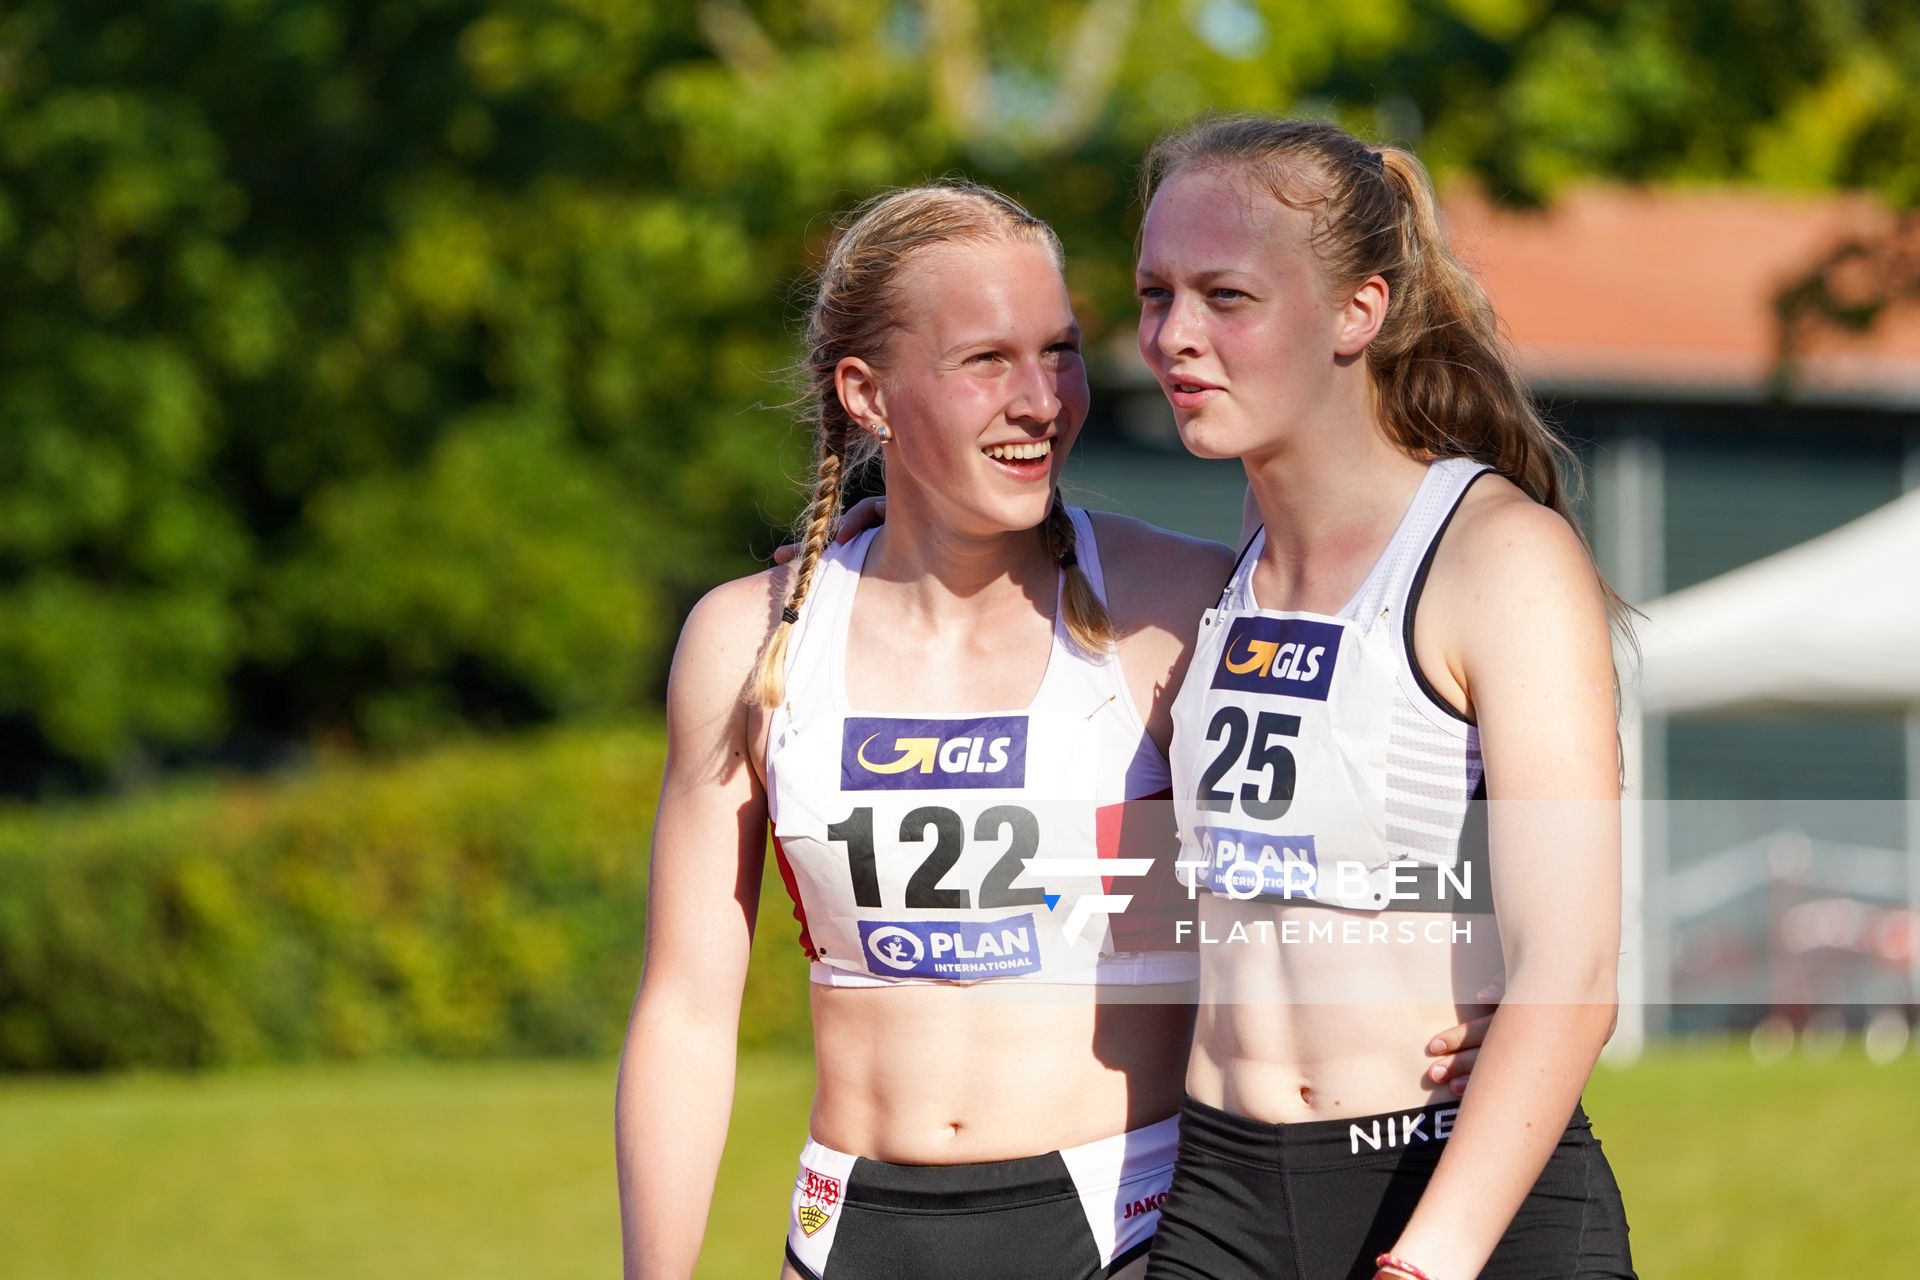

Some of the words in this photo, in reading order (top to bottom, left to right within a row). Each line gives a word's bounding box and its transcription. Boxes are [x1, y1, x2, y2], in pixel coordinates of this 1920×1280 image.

[1271, 643, 1325, 682] GLS
[938, 737, 1011, 773] GLS
[1196, 706, 1302, 821] 25
[827, 805, 1046, 909] 122
[1215, 840, 1310, 875] PLAN
[930, 927, 1030, 959] PLAN
[934, 957, 1033, 973] INTERNATIONAL
[1350, 1108, 1459, 1154] NIKE
